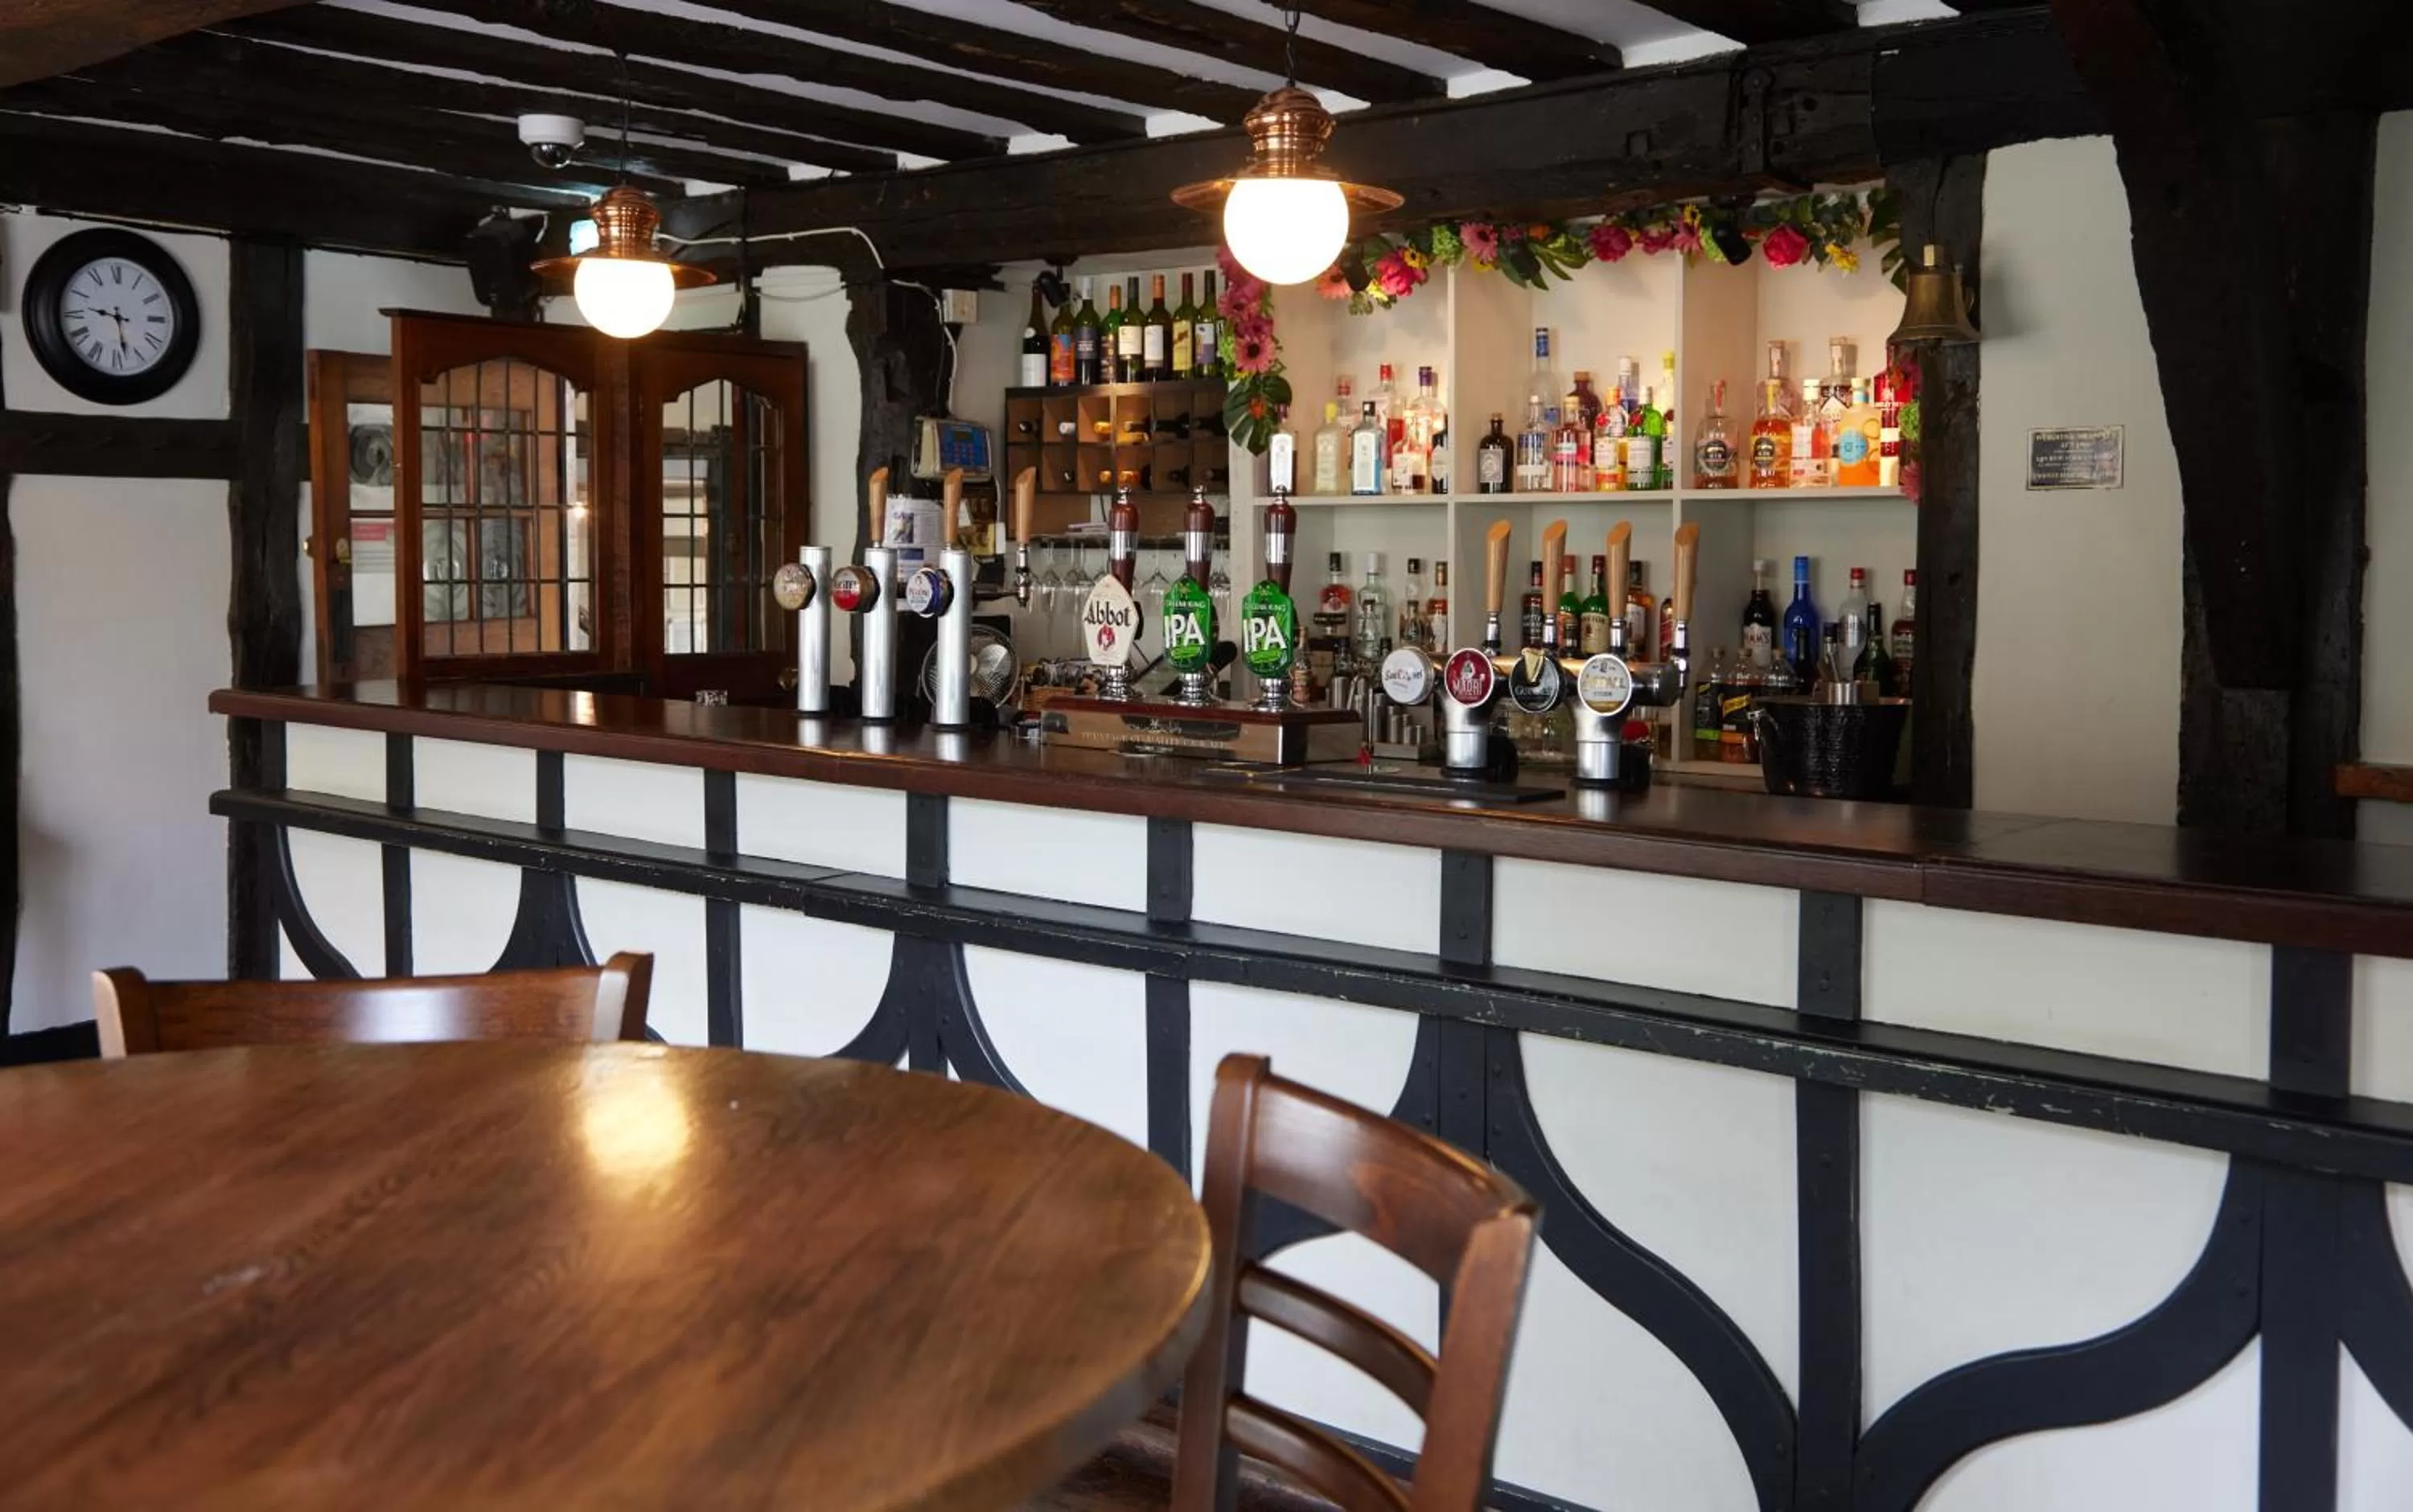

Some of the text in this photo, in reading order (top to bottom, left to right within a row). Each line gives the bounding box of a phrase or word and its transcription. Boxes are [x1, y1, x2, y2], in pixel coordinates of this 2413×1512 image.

[1083, 599, 1132, 627] Abbot
[1164, 612, 1206, 648] IPA
[1243, 615, 1287, 653] IPA
